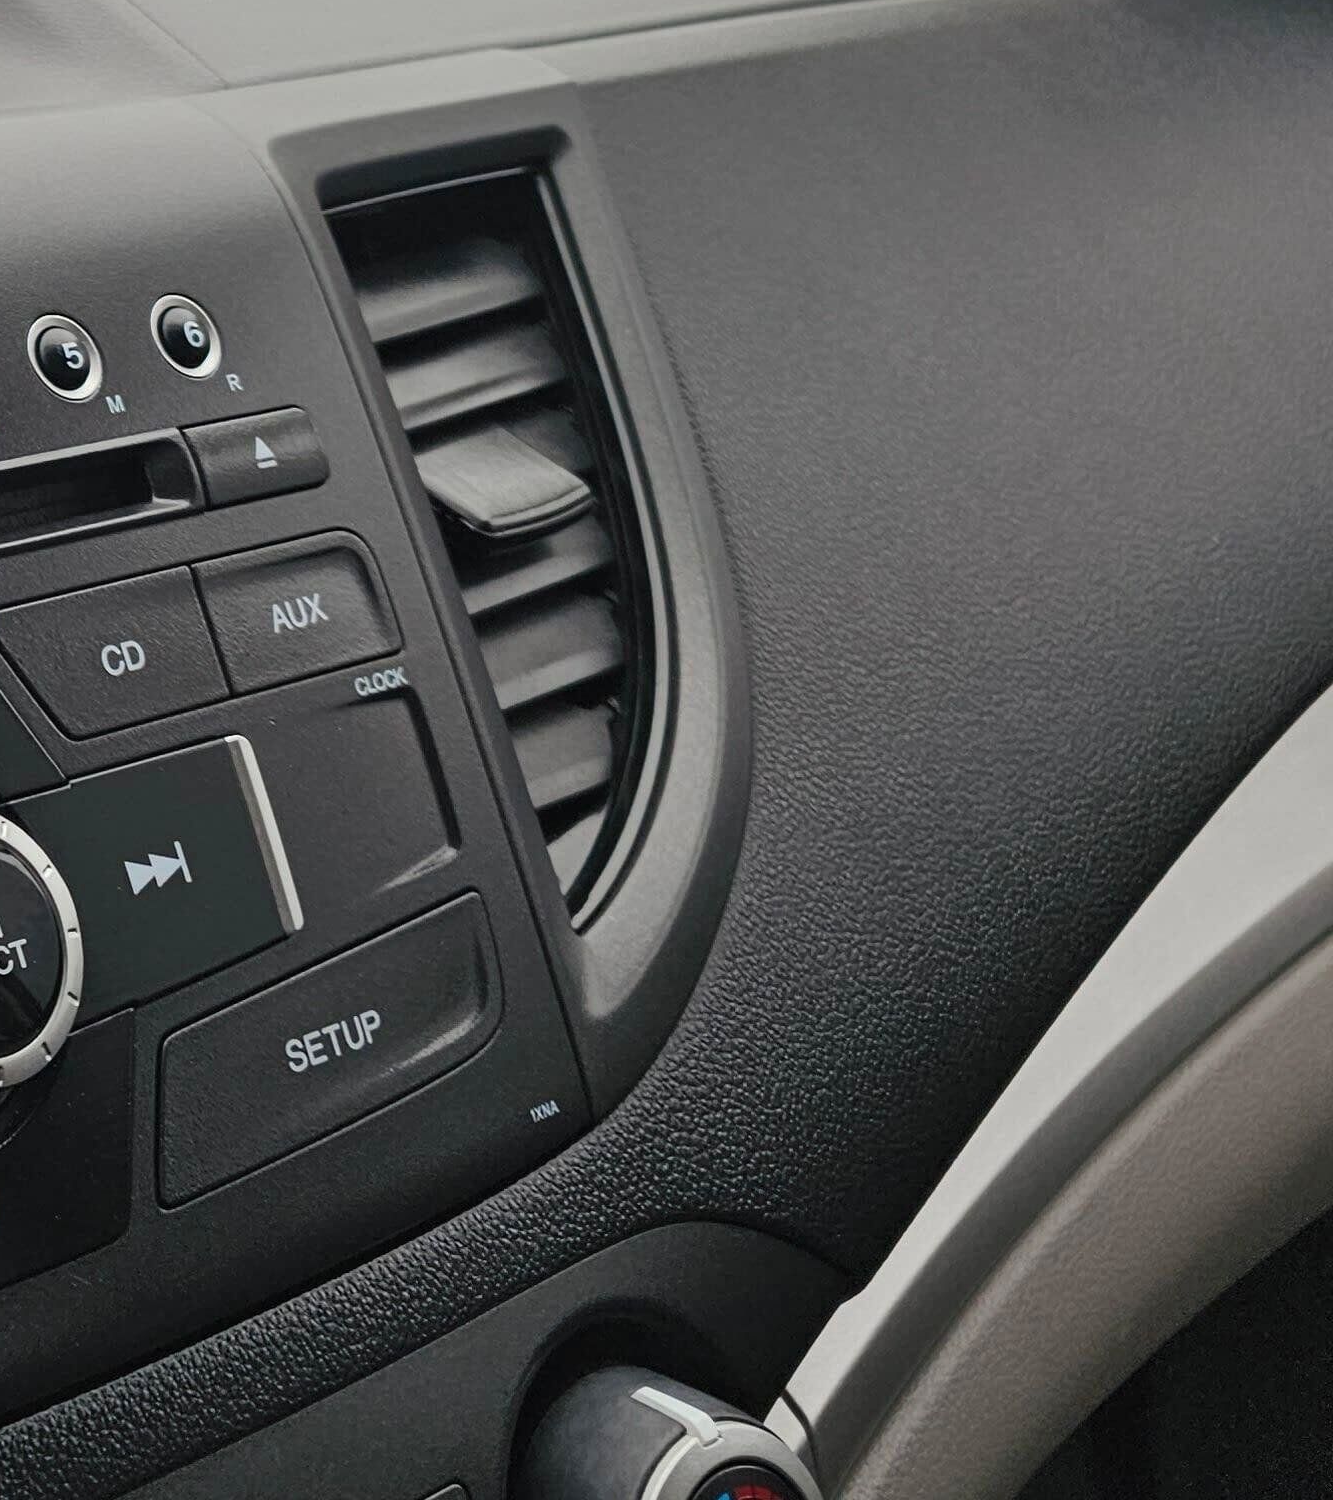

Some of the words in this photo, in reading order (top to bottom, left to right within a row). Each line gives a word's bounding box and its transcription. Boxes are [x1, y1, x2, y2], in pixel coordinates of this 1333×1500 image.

[182, 320, 205, 349] 6
[60, 341, 84, 370] 5
[225, 373, 244, 392] R
[105, 394, 126, 414] M
[270, 593, 330, 635] AUX
[100, 639, 146, 677] CD
[354, 666, 410, 698] CLOCK
[284, 1009, 382, 1073] SETUP
